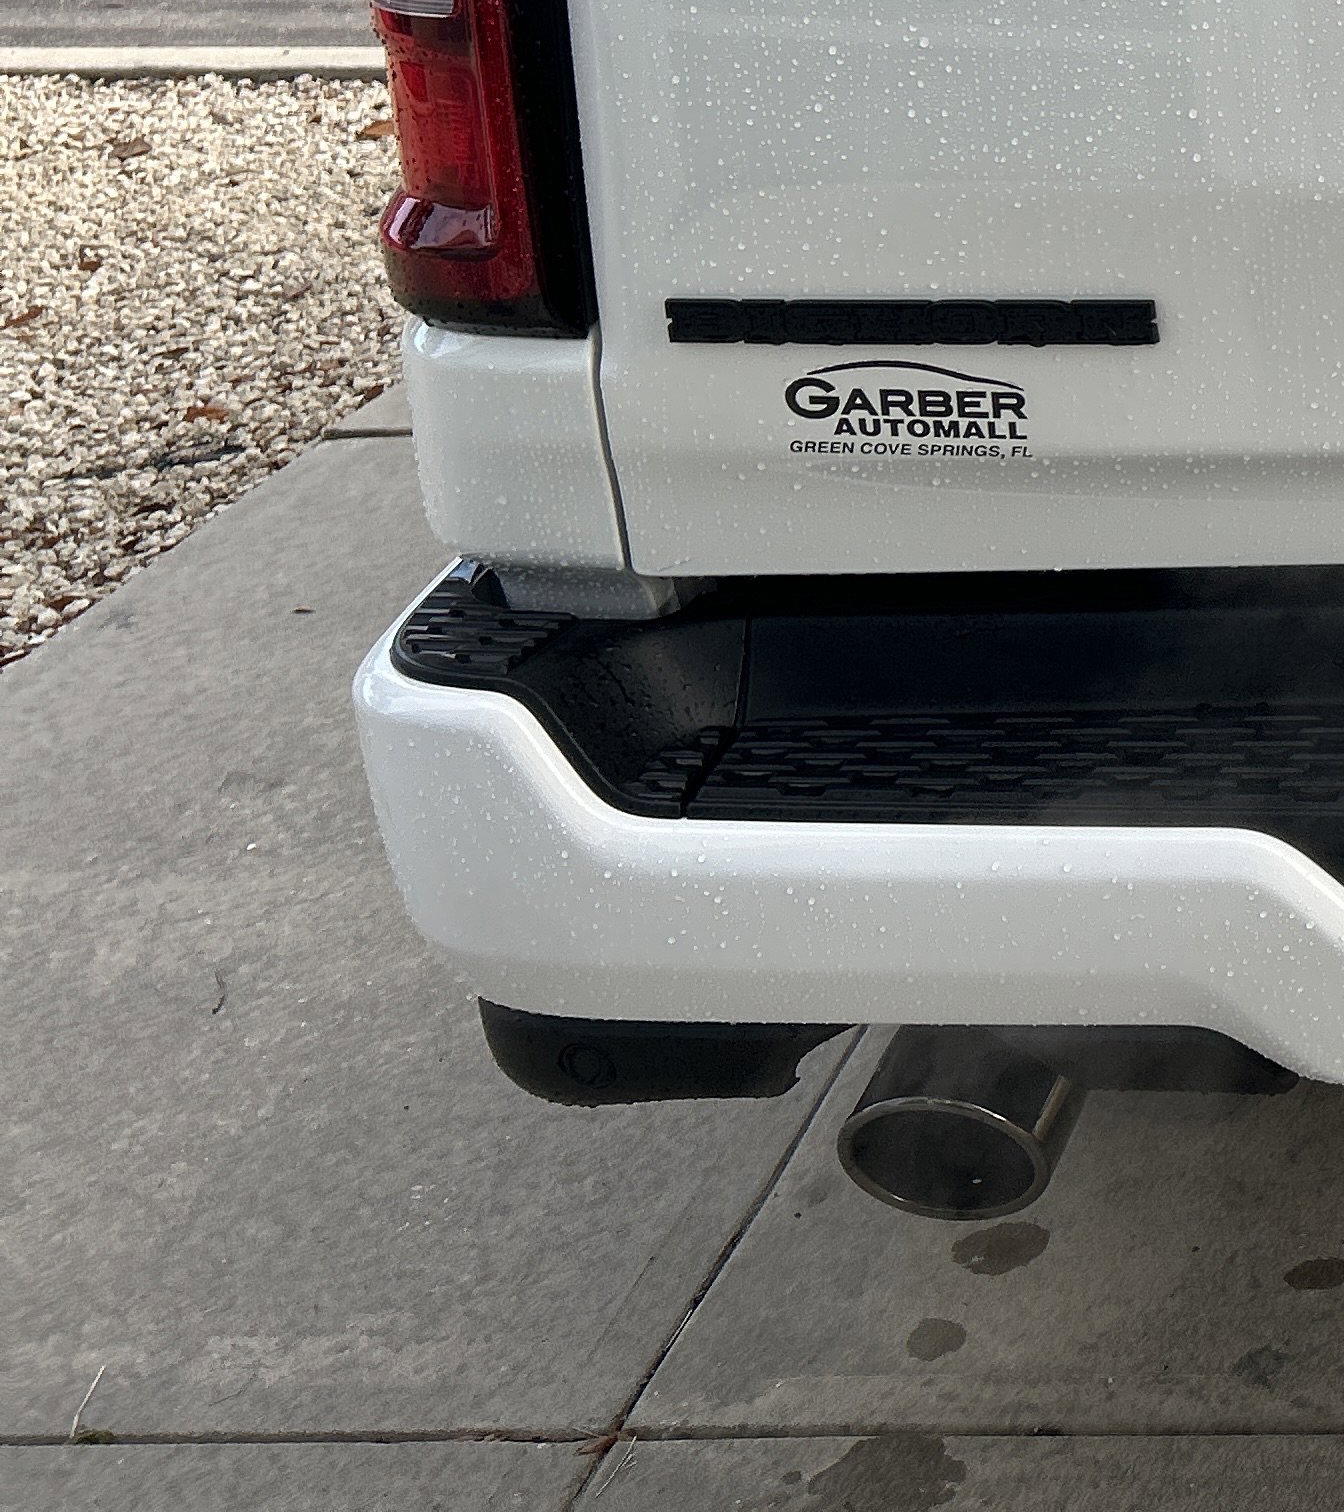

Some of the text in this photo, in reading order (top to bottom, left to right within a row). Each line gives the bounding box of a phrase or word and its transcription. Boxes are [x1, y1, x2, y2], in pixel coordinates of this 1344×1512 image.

[785, 377, 1028, 419] GARBER
[834, 418, 1027, 440] AUTOMALL
[790, 440, 1033, 459] GREEN COVE SPRINGS, FL
